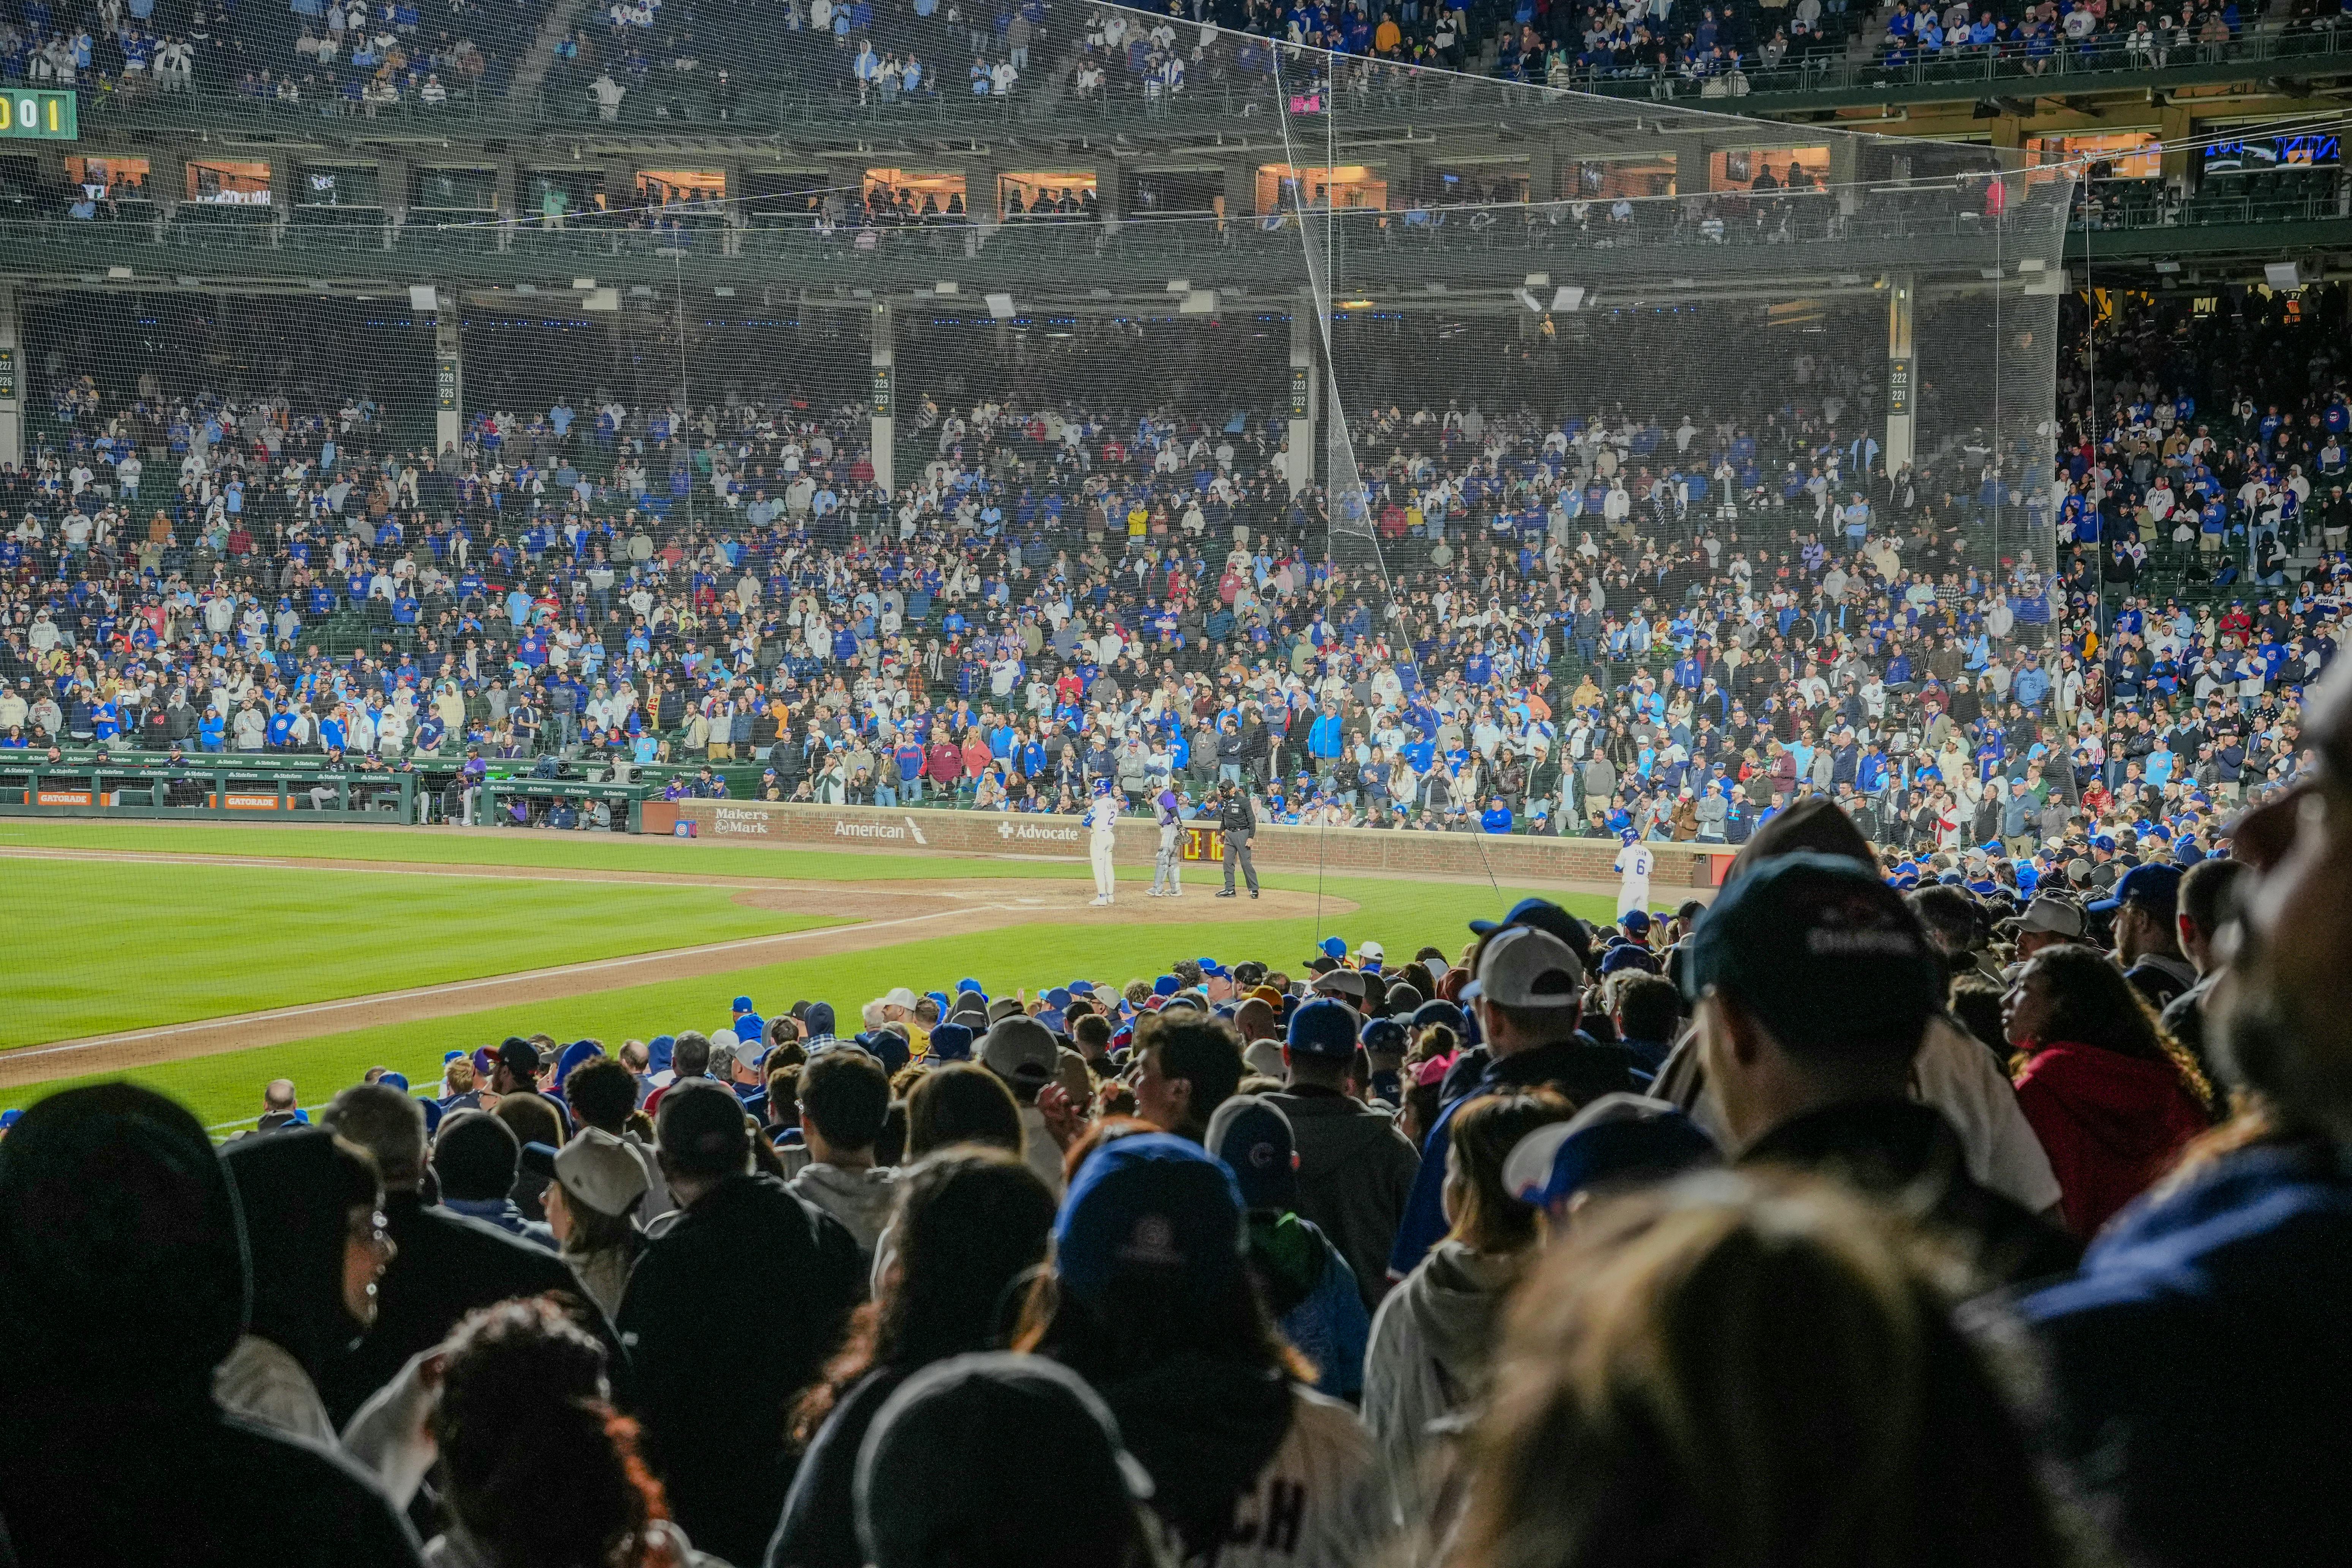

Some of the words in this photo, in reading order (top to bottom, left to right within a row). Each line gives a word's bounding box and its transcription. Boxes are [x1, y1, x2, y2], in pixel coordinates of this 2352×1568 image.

[20, 99, 36, 127] 0
[0, 361, 11, 370] 227
[0, 377, 12, 386] 226
[440, 373, 454, 382] 226
[1892, 373, 1907, 383] 222
[875, 379, 888, 388] 225
[1293, 380, 1306, 390] 223
[440, 389, 454, 398] 225
[1892, 390, 1905, 400] 221
[875, 395, 888, 404] 223
[1292, 397, 1305, 406] 222
[975, 639, 993, 648] CUBS
[41, 795, 87, 803] GATORADE
[228, 798, 274, 806] GATORADE
[715, 808, 769, 820] Maker's
[1107, 811, 1115, 826] 2
[729, 821, 768, 833] Mark
[834, 820, 904, 839] American
[1016, 824, 1078, 841] Advocate
[1636, 858, 1645, 875] 6
